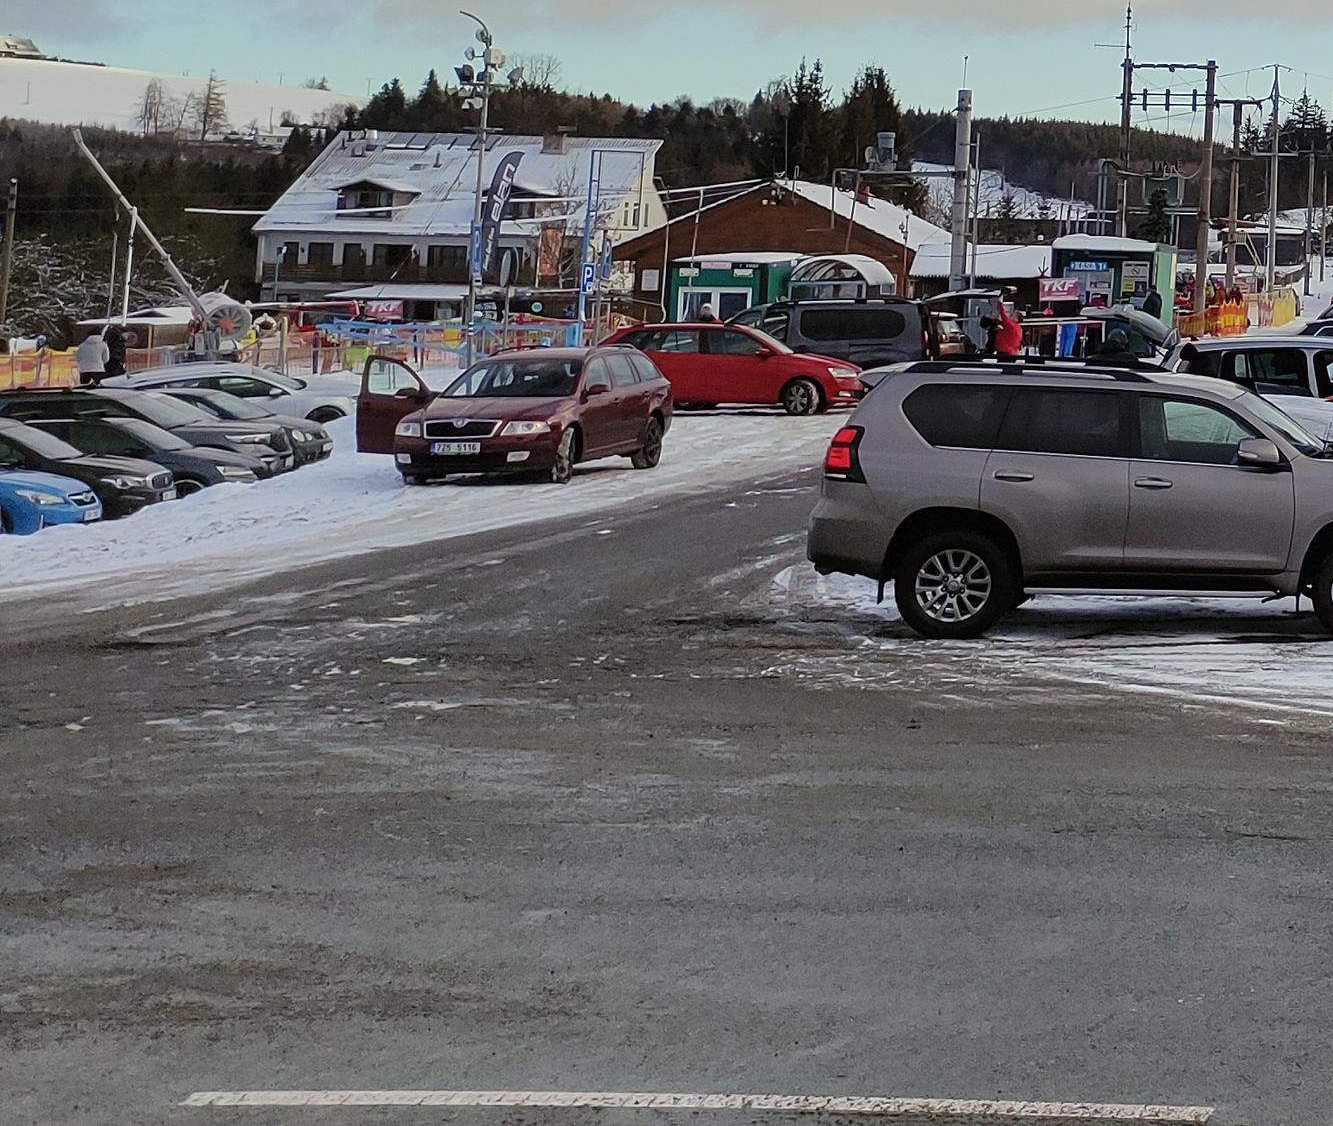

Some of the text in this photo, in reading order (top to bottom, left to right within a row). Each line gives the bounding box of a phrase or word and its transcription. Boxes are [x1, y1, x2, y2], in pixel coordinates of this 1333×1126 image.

[491, 162, 516, 222] elan
[1074, 261, 1096, 270] KASA
[584, 266, 593, 285] P
[1042, 280, 1075, 292] TKF
